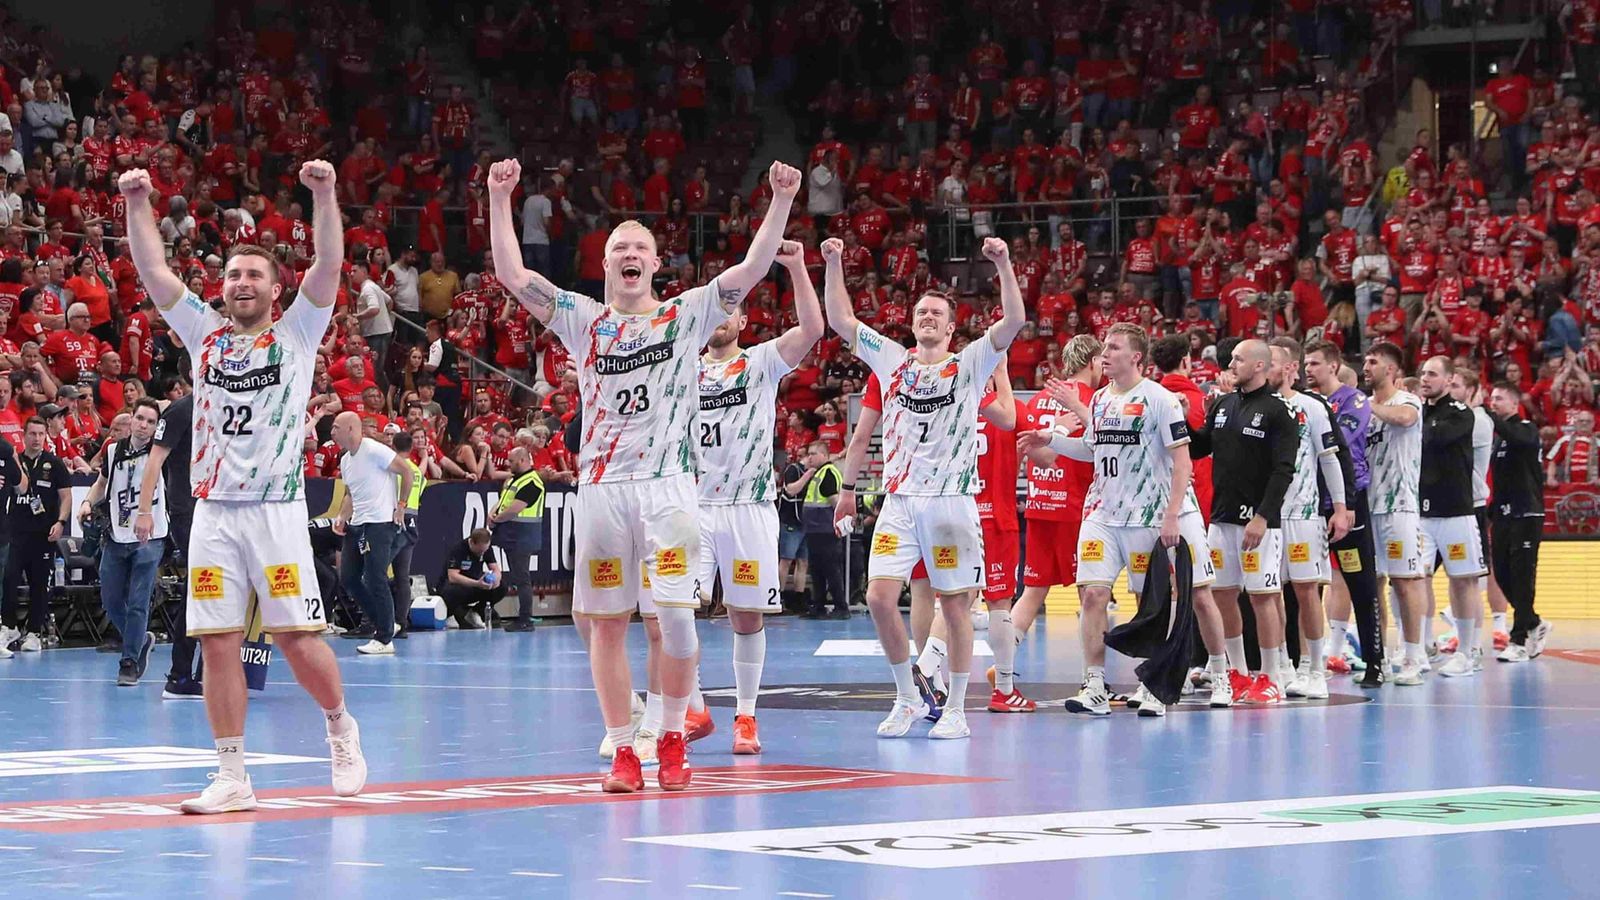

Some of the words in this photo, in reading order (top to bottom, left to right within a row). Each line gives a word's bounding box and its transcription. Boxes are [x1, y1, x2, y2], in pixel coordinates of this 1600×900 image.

[292, 226, 306, 241] 66
[66, 341, 82, 352] 59
[606, 347, 670, 371] Humanas
[616, 383, 650, 416] 23
[222, 404, 254, 437] 22
[700, 422, 722, 448] 21
[917, 421, 929, 444] 7
[1101, 456, 1118, 478] 10
[1240, 504, 1254, 520] 24
[1422, 499, 1431, 512] 9
[1408, 557, 1417, 571] 15
[594, 574, 618, 582] LOTTO
[973, 566, 982, 583] 7
[1264, 573, 1278, 588] 24
[195, 585, 219, 593] LOTTO
[271, 581, 296, 591] LOTTO
